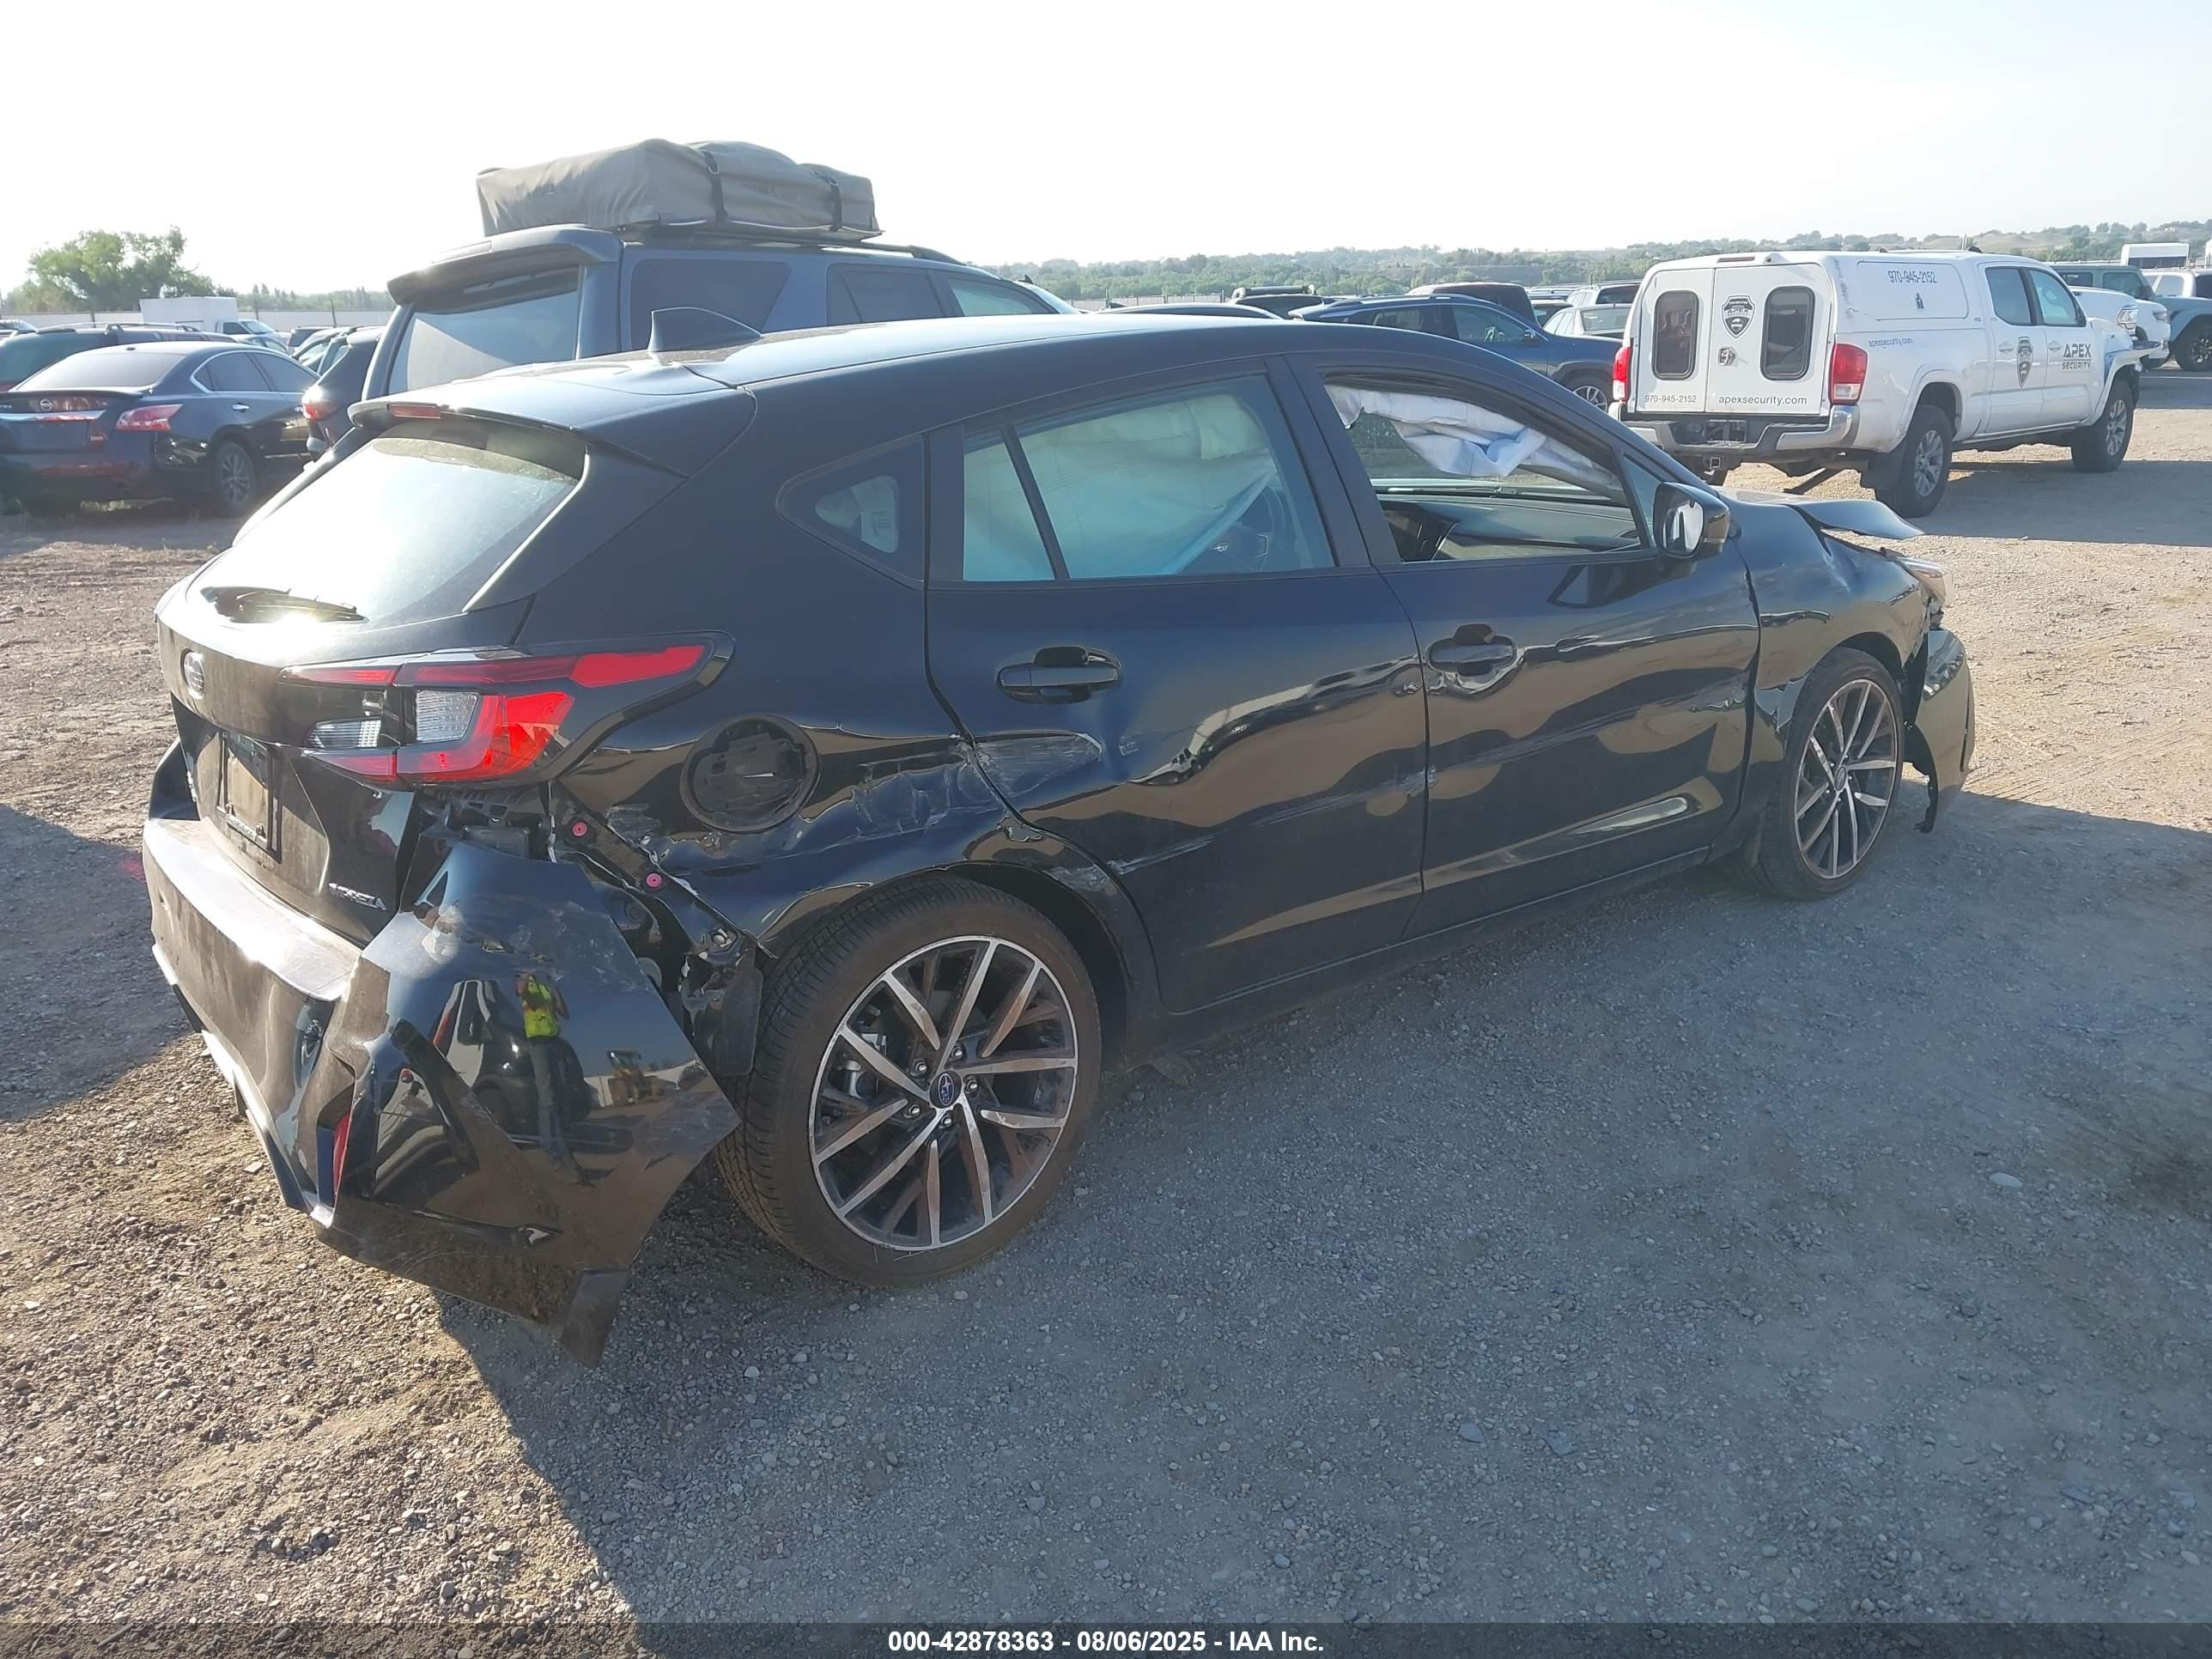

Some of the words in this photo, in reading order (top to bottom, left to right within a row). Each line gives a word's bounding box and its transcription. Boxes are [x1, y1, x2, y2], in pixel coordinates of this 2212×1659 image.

[1888, 270, 1937, 283] 970-945-2152
[2063, 343, 2092, 358] APEX
[2061, 362, 2092, 370] SECURITY
[1644, 394, 1697, 403] 970-945-2152
[1718, 395, 1808, 405] apexsecurity.com
